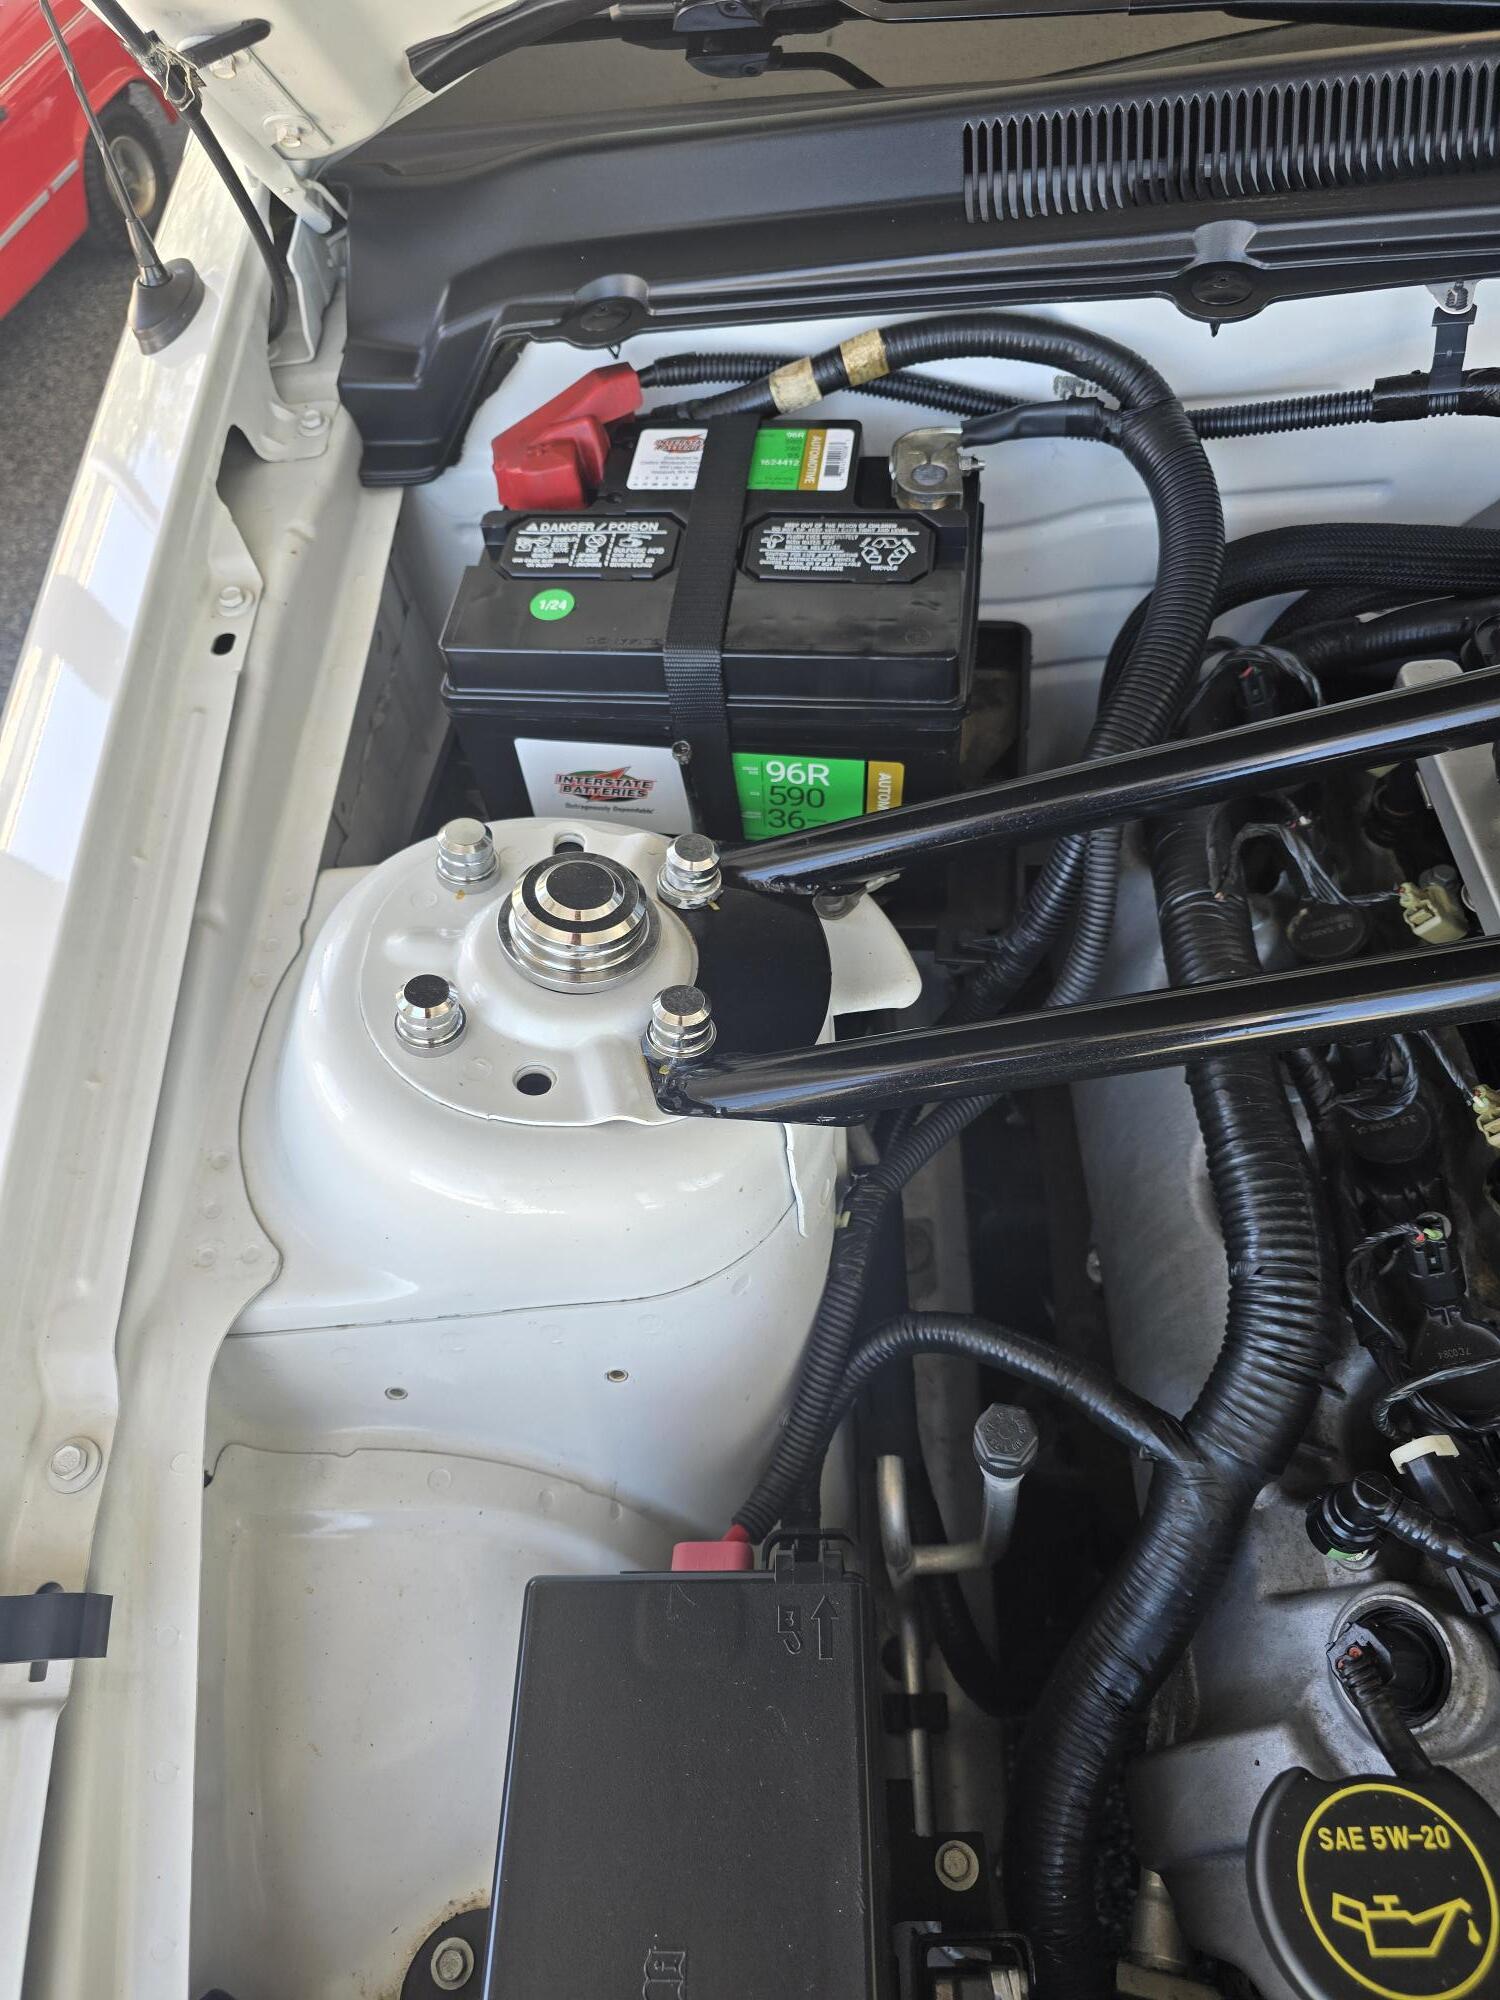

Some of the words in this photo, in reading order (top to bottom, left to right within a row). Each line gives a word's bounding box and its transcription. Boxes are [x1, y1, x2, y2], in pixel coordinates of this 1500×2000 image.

[804, 435, 822, 484] AUTOMOTIVE
[540, 522, 595, 532] DANGER
[608, 521, 659, 532] POISON
[539, 600, 568, 611] 1/24
[555, 773, 656, 790] INTERSTATE
[766, 760, 830, 786] 96R
[561, 785, 648, 798] BATTERIES
[769, 786, 825, 809] 590
[768, 809, 806, 830] 36
[1317, 1826, 1367, 1851] SAE
[1369, 1825, 1451, 1850] 5W-20
